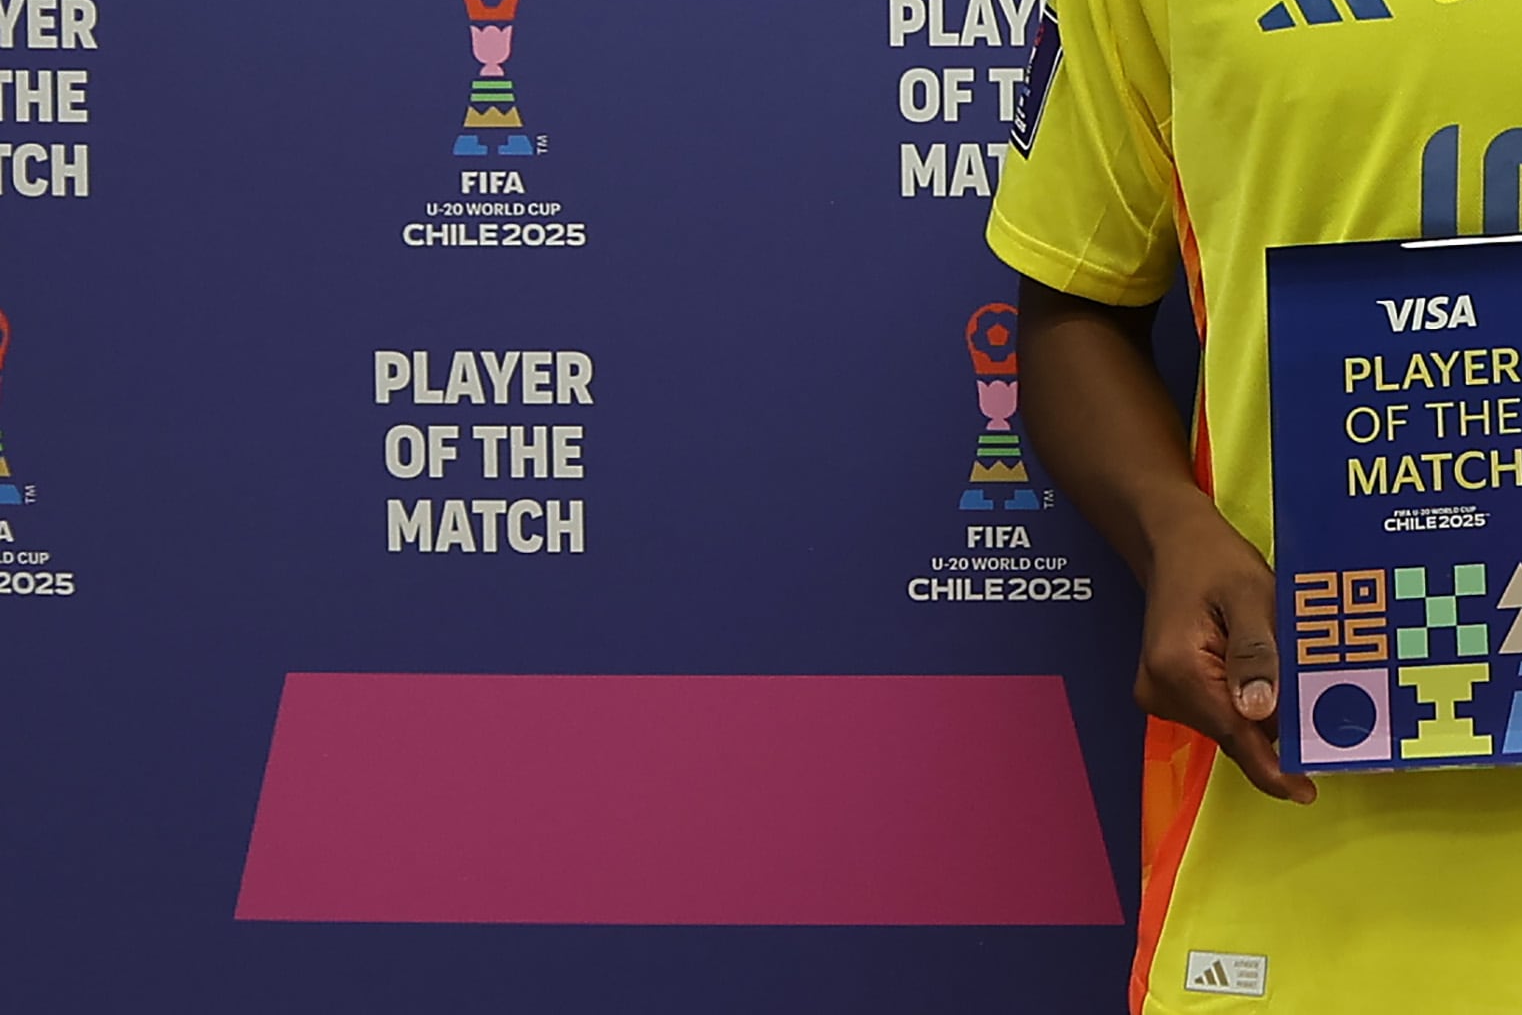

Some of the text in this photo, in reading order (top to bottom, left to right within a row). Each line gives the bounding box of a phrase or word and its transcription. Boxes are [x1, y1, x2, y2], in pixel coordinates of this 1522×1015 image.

[0, 69, 88, 123] HE
[899, 67, 975, 123] OF
[461, 171, 525, 194] FIFA
[426, 202, 561, 217] U-20 WORLD CUP
[1375, 294, 1477, 333] VISA
[374, 350, 594, 405] PLAYER
[1344, 347, 1522, 394] PLAYER
[1344, 402, 1410, 444] OF
[385, 424, 584, 479] OF THE
[387, 499, 584, 554] MATCH
[967, 526, 1031, 548] FIFA
[17, 551, 50, 565] CUP
[931, 557, 1068, 571] U-20 WORLD CUP
